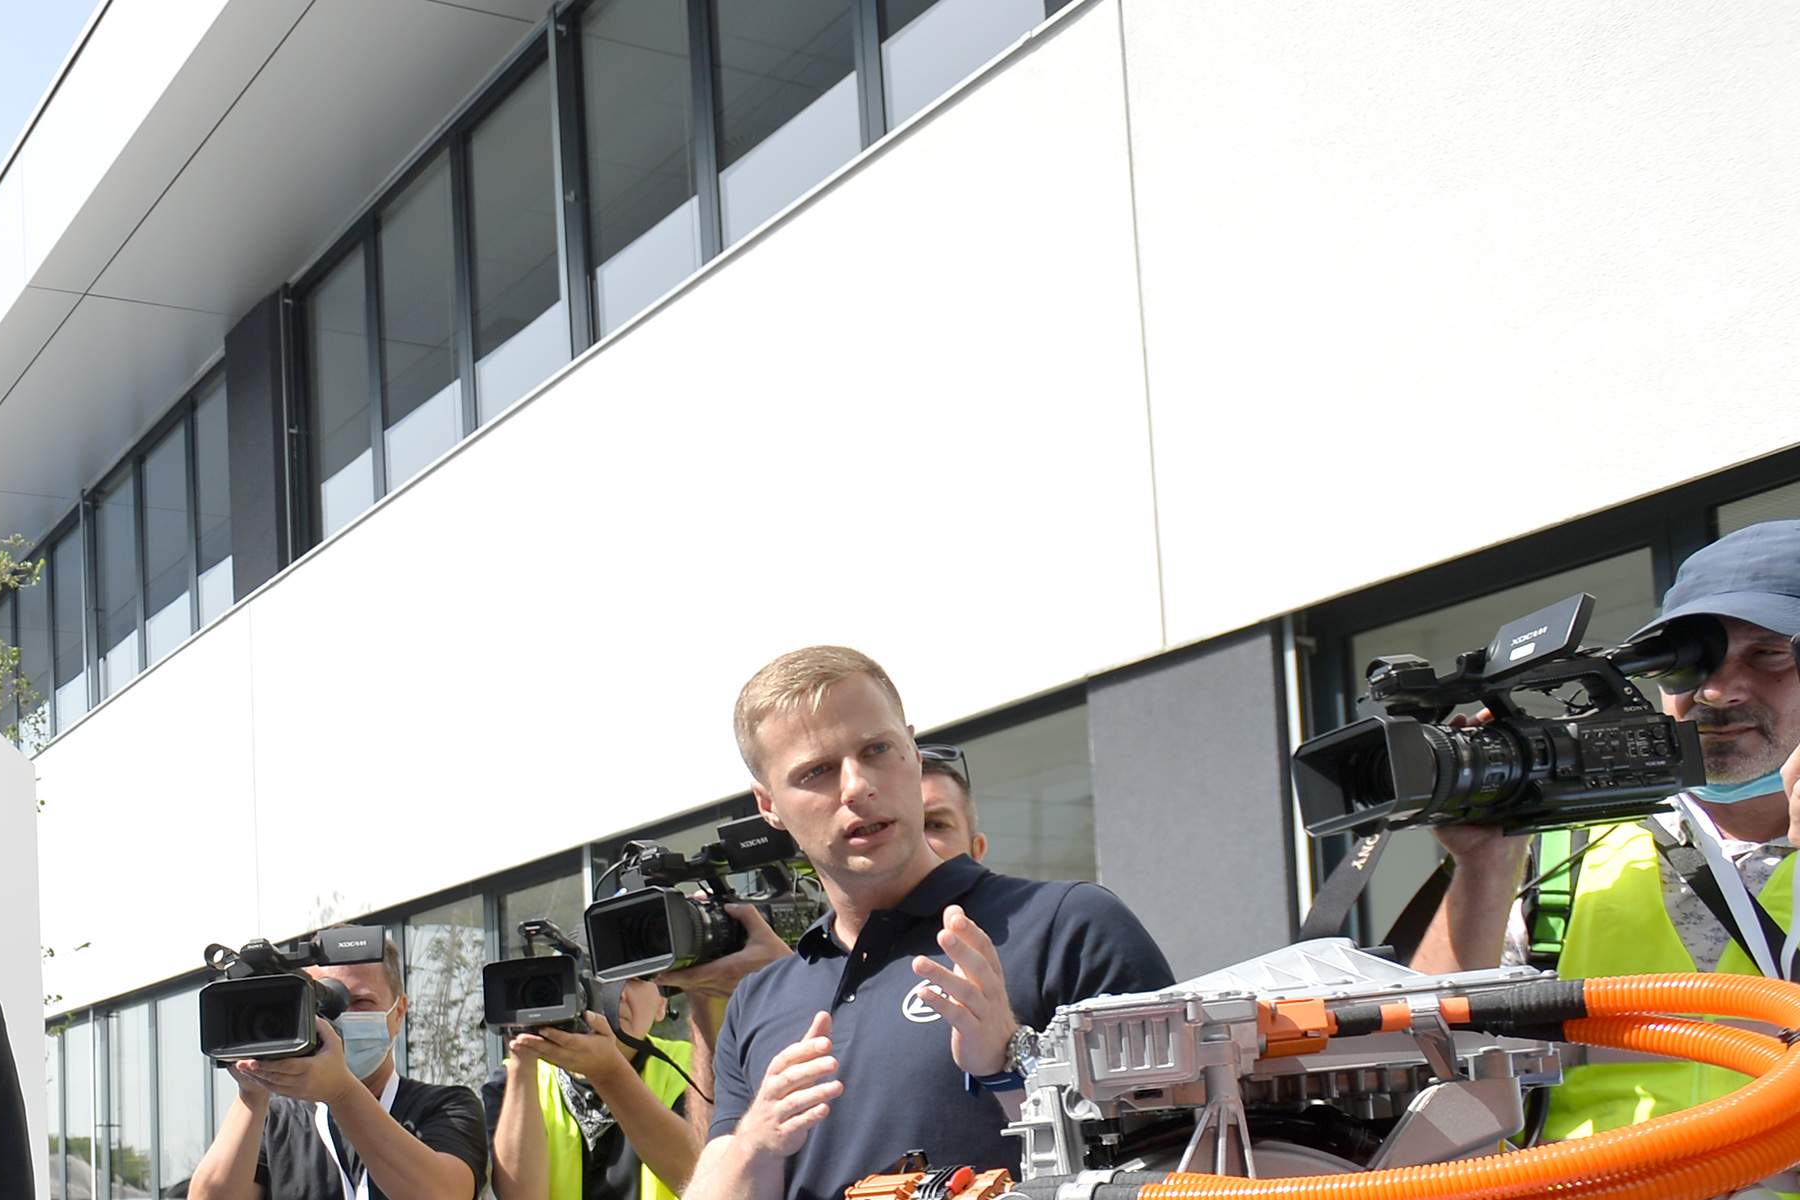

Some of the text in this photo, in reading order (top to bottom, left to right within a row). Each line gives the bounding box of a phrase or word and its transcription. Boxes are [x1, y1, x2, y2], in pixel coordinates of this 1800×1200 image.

[1623, 704, 1649, 712] SONY
[739, 837, 769, 849] XDCAM
[1351, 833, 1380, 870] ONY
[338, 940, 367, 948] XDCAM
